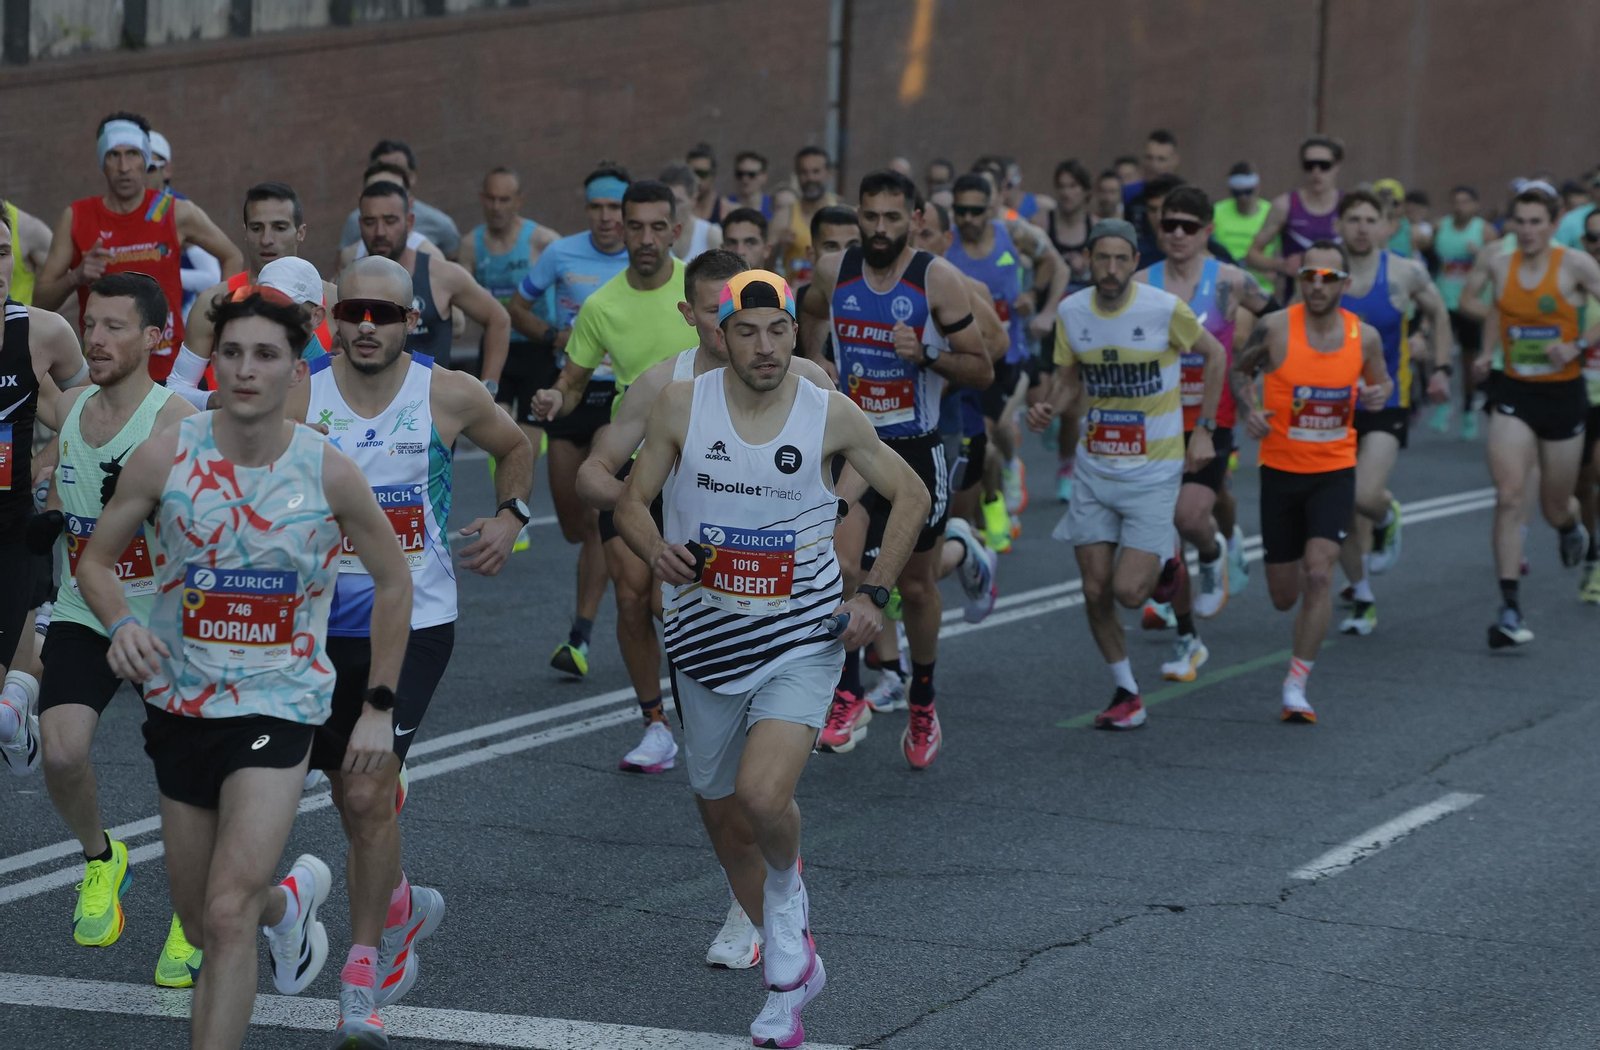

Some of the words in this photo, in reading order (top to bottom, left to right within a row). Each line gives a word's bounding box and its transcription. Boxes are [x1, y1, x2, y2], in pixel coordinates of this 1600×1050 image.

[866, 368, 904, 378] ZURICH
[1079, 359, 1161, 385] EHOBIA
[860, 395, 900, 412] TRABU
[356, 440, 384, 448] VIATOR
[731, 533, 784, 547] ZURICH
[732, 558, 760, 572] 1016
[222, 575, 284, 590] ZURICH
[713, 572, 778, 595] ALBERT
[227, 603, 252, 617] 746
[199, 619, 277, 642] DORIAN
